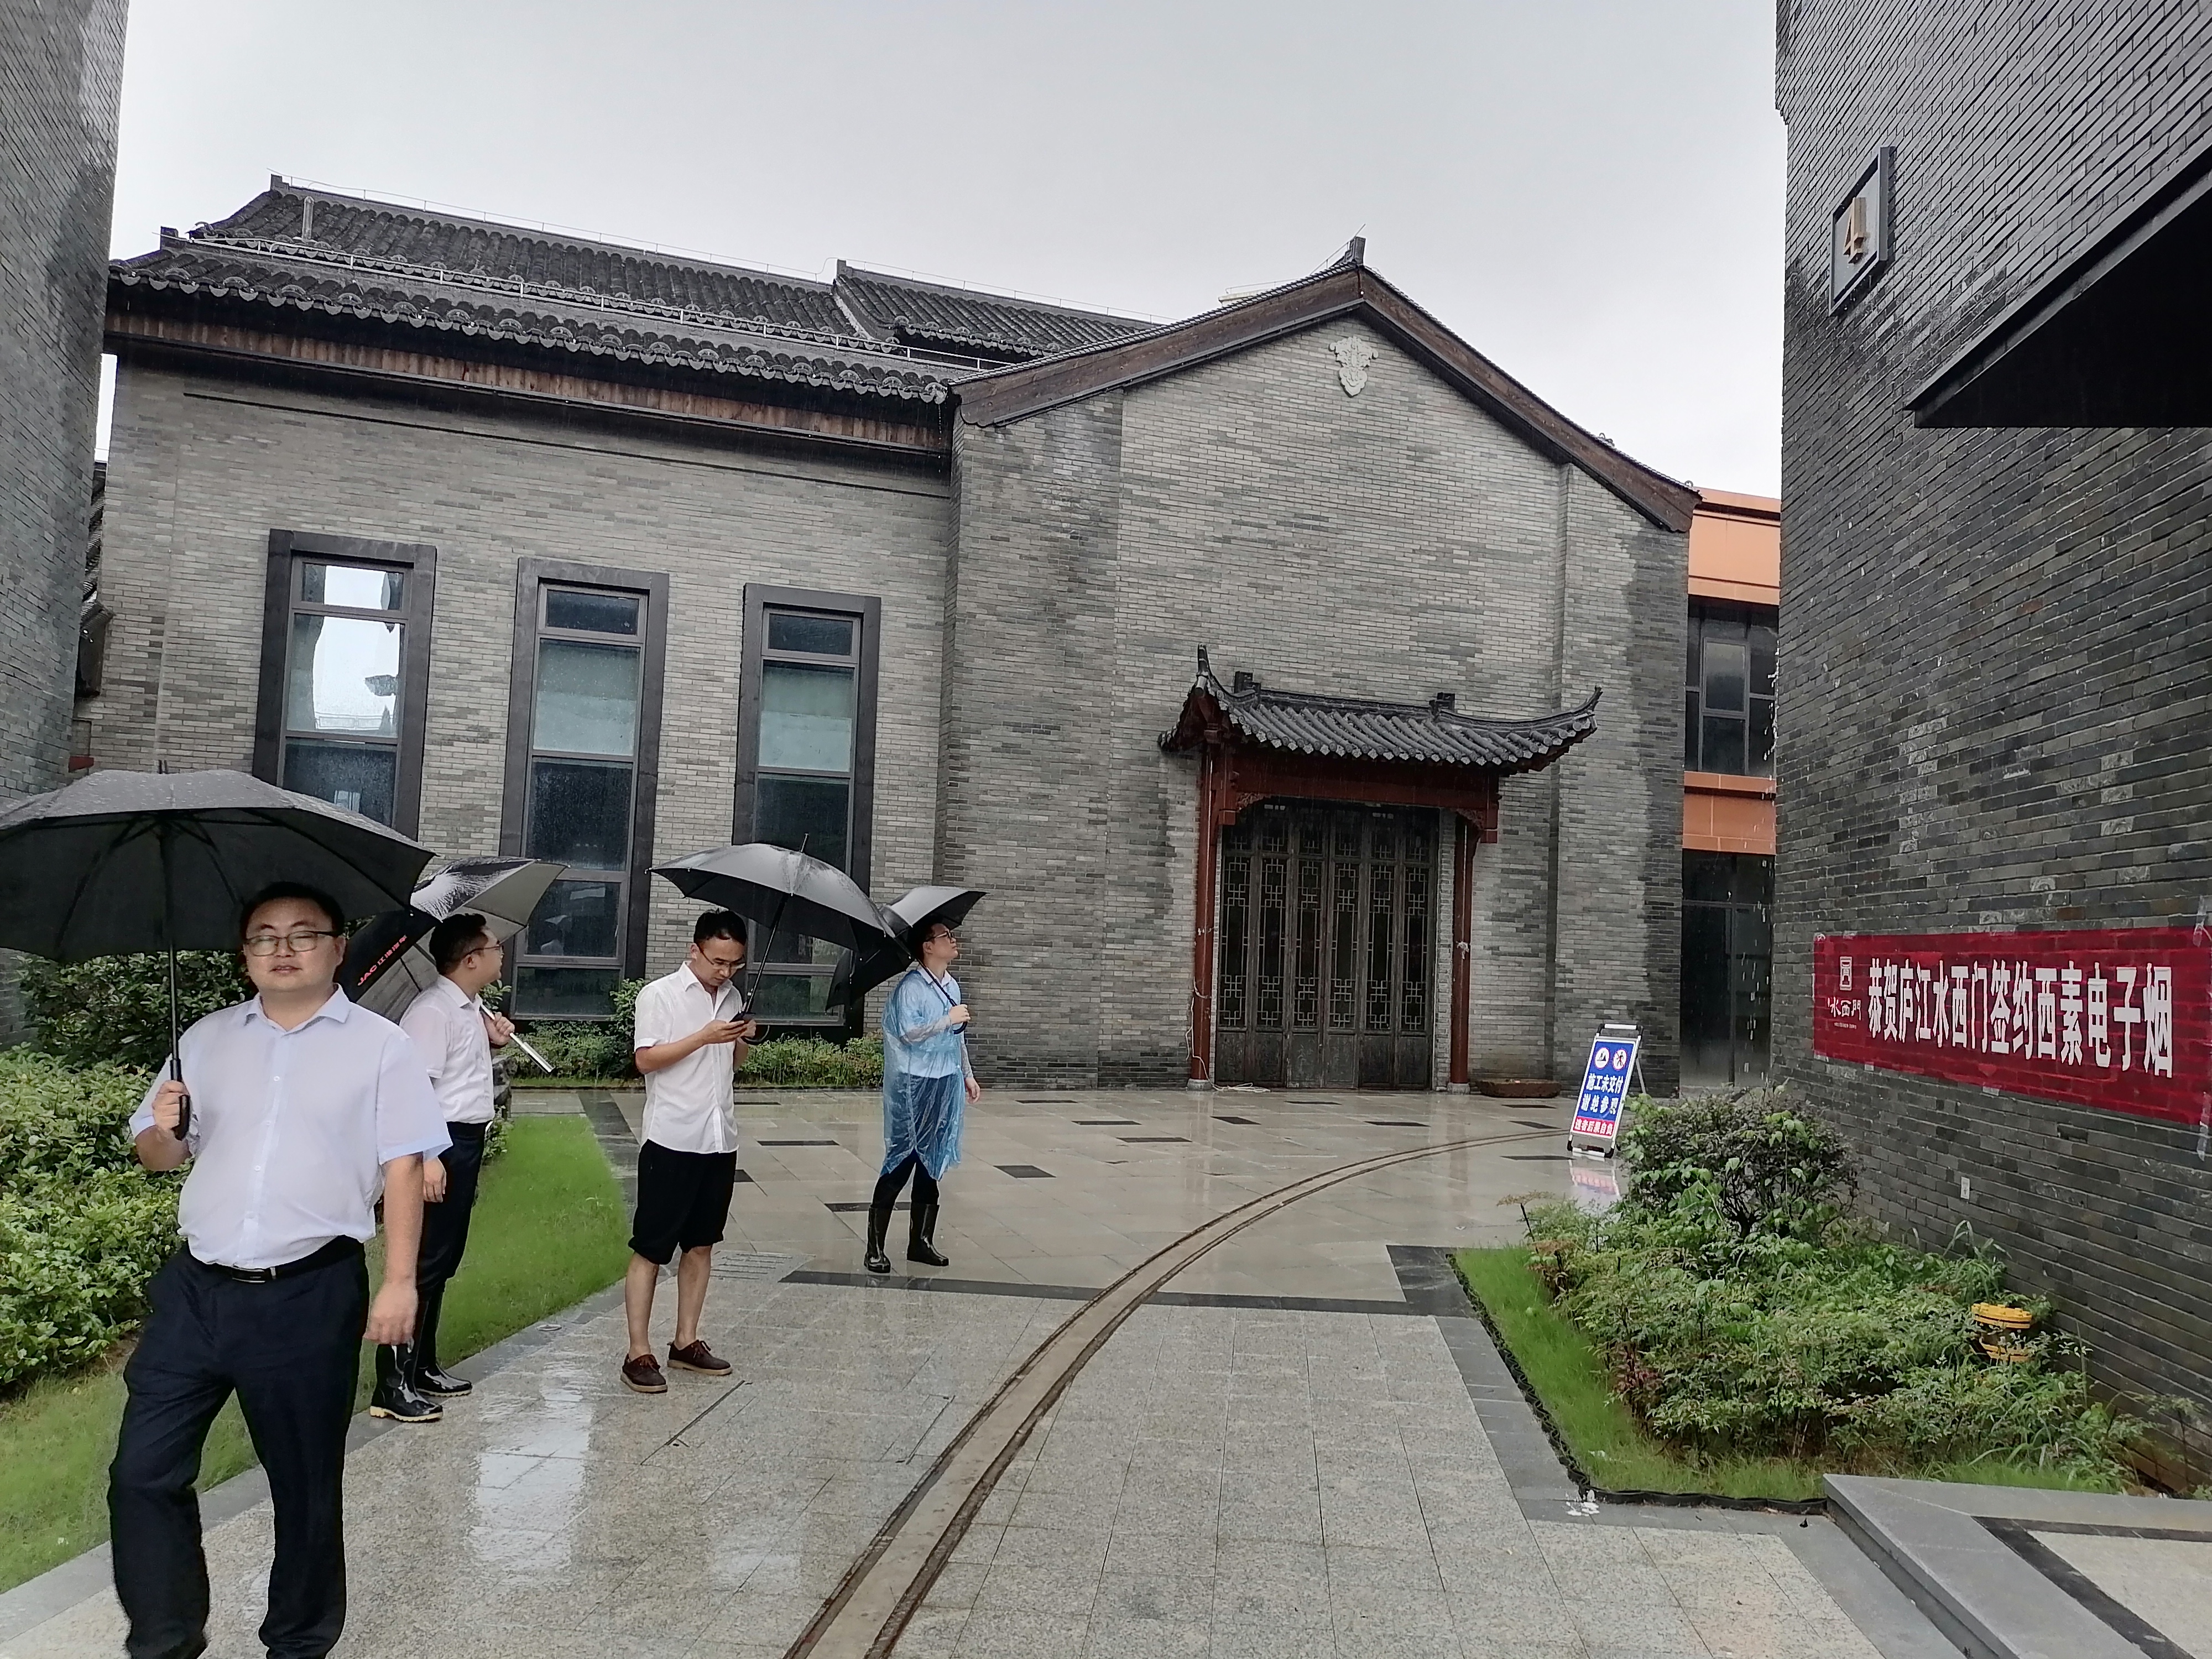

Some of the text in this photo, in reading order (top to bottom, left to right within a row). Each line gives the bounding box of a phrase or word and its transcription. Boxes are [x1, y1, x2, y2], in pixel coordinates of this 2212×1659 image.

[1843, 197, 1866, 264] 4
[358, 965, 377, 985] JAC
[1868, 958, 2172, 1078] 恭贺庐江水西门签约西素电子烟
